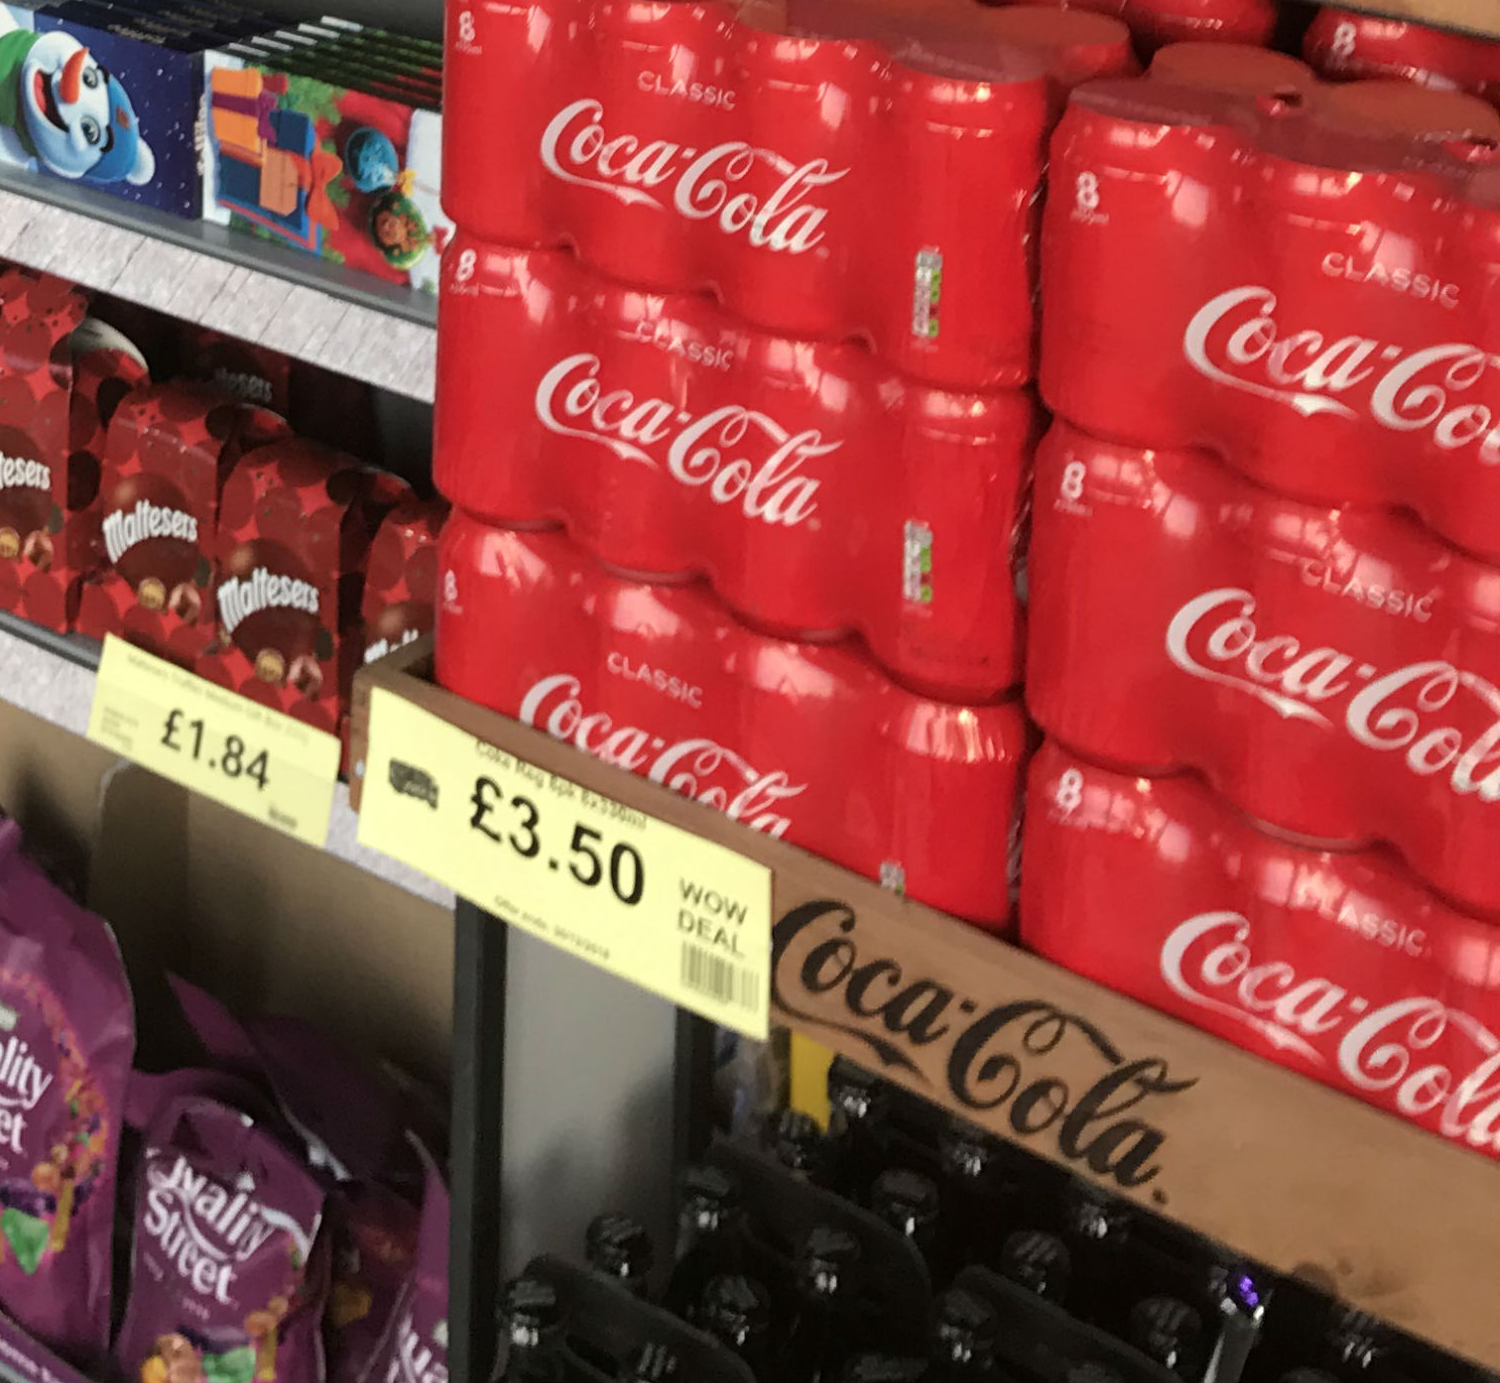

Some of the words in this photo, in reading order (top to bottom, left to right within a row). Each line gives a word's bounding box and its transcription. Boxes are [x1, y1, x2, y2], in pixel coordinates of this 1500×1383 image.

[457, 10, 477, 42] 8
[637, 68, 737, 112] CLASSIC
[539, 98, 852, 256] Coca-Cola
[1076, 172, 1100, 212] 8
[456, 249, 476, 280] 8
[1321, 251, 1462, 310] CLASSIC
[635, 319, 736, 372] CLASSIC
[535, 351, 845, 529] Coca-Cola
[1061, 461, 1086, 499] 8
[102, 498, 198, 564] Maltesers
[216, 566, 320, 634] Maltesers
[443, 570, 459, 603] 8
[1301, 561, 1435, 622] CLASSIC
[607, 651, 705, 709] CLASSIC
[160, 707, 270, 792] £1.84
[518, 673, 809, 842] Coca-Cola
[1057, 768, 1083, 812] 8
[469, 775, 645, 907] £3.50
[679, 877, 749, 927] WOW
[676, 909, 746, 959] DEAL
[772, 899, 1201, 1189] Coca-Cola
[143, 1185, 238, 1304] Street
